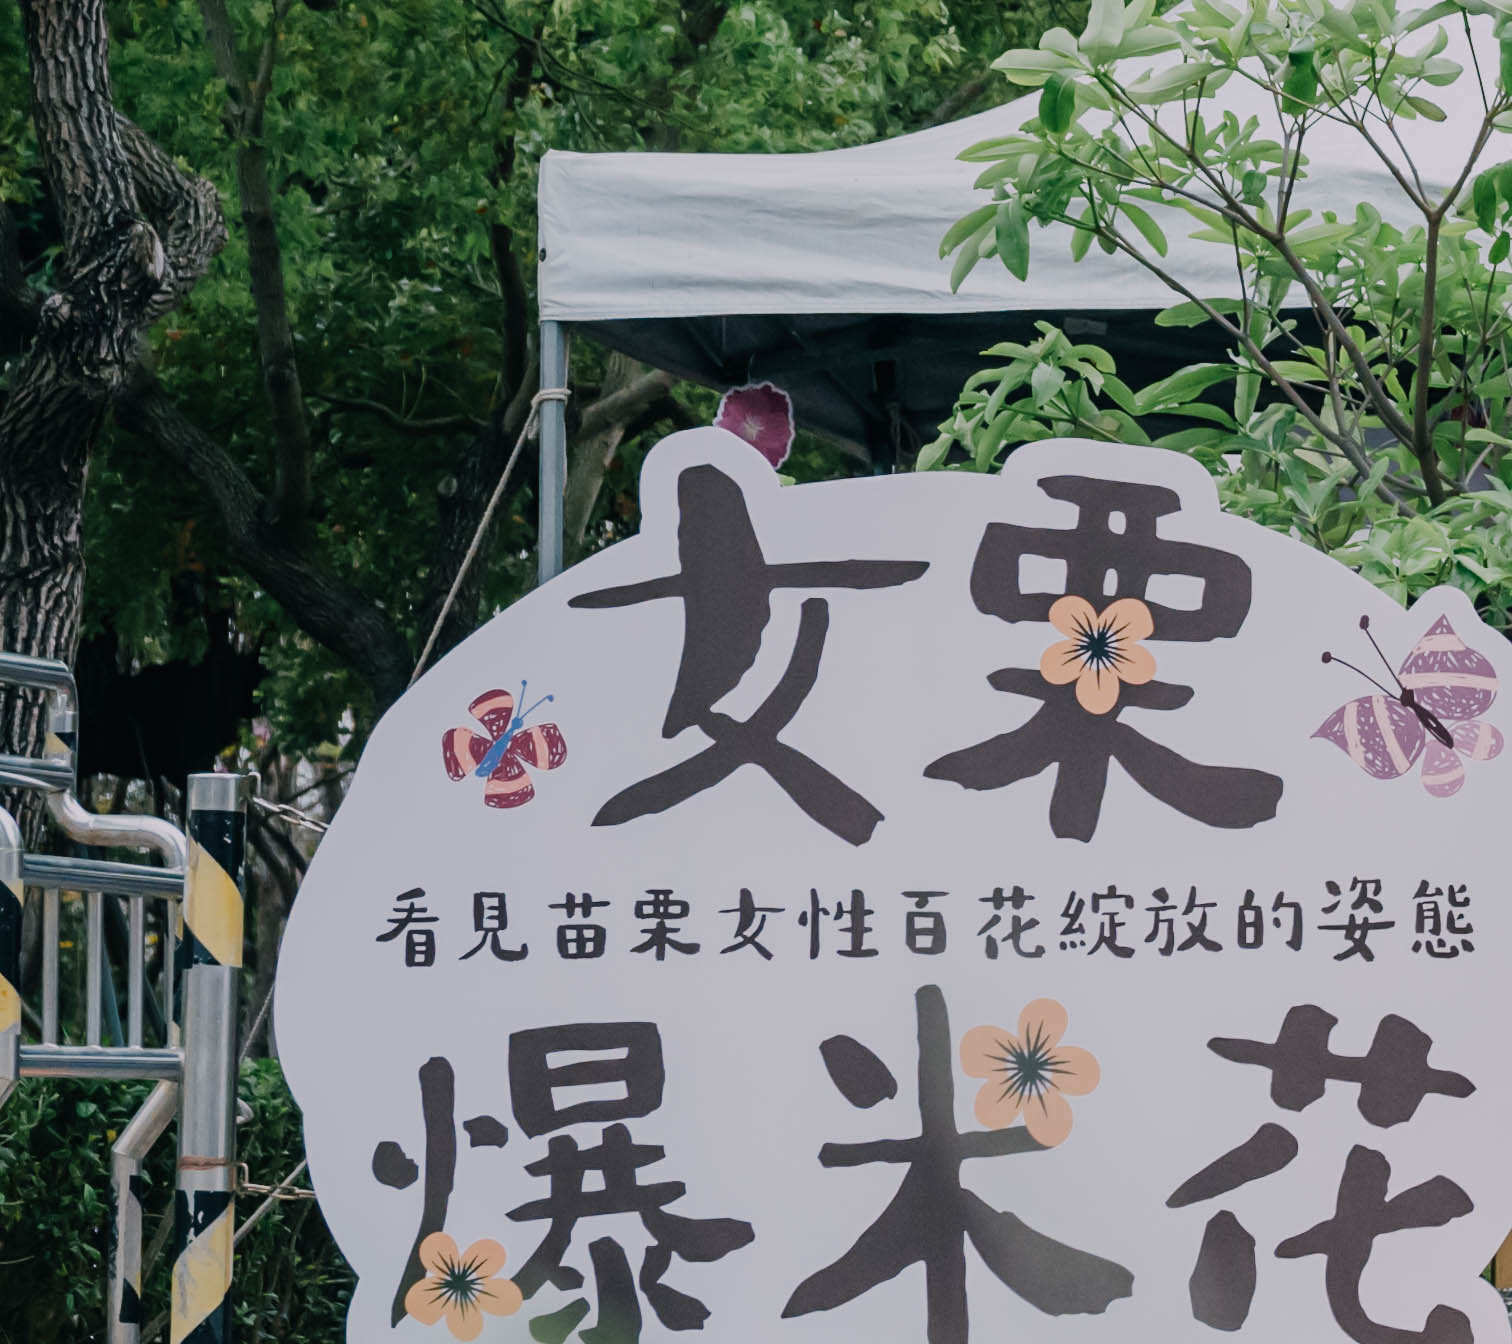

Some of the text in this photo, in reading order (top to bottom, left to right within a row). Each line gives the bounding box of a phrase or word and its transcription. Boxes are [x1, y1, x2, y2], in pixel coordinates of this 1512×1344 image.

[567, 463, 1284, 846] 女栗
[374, 876, 1476, 968] 看見苗栗女性百花綻放的姿態
